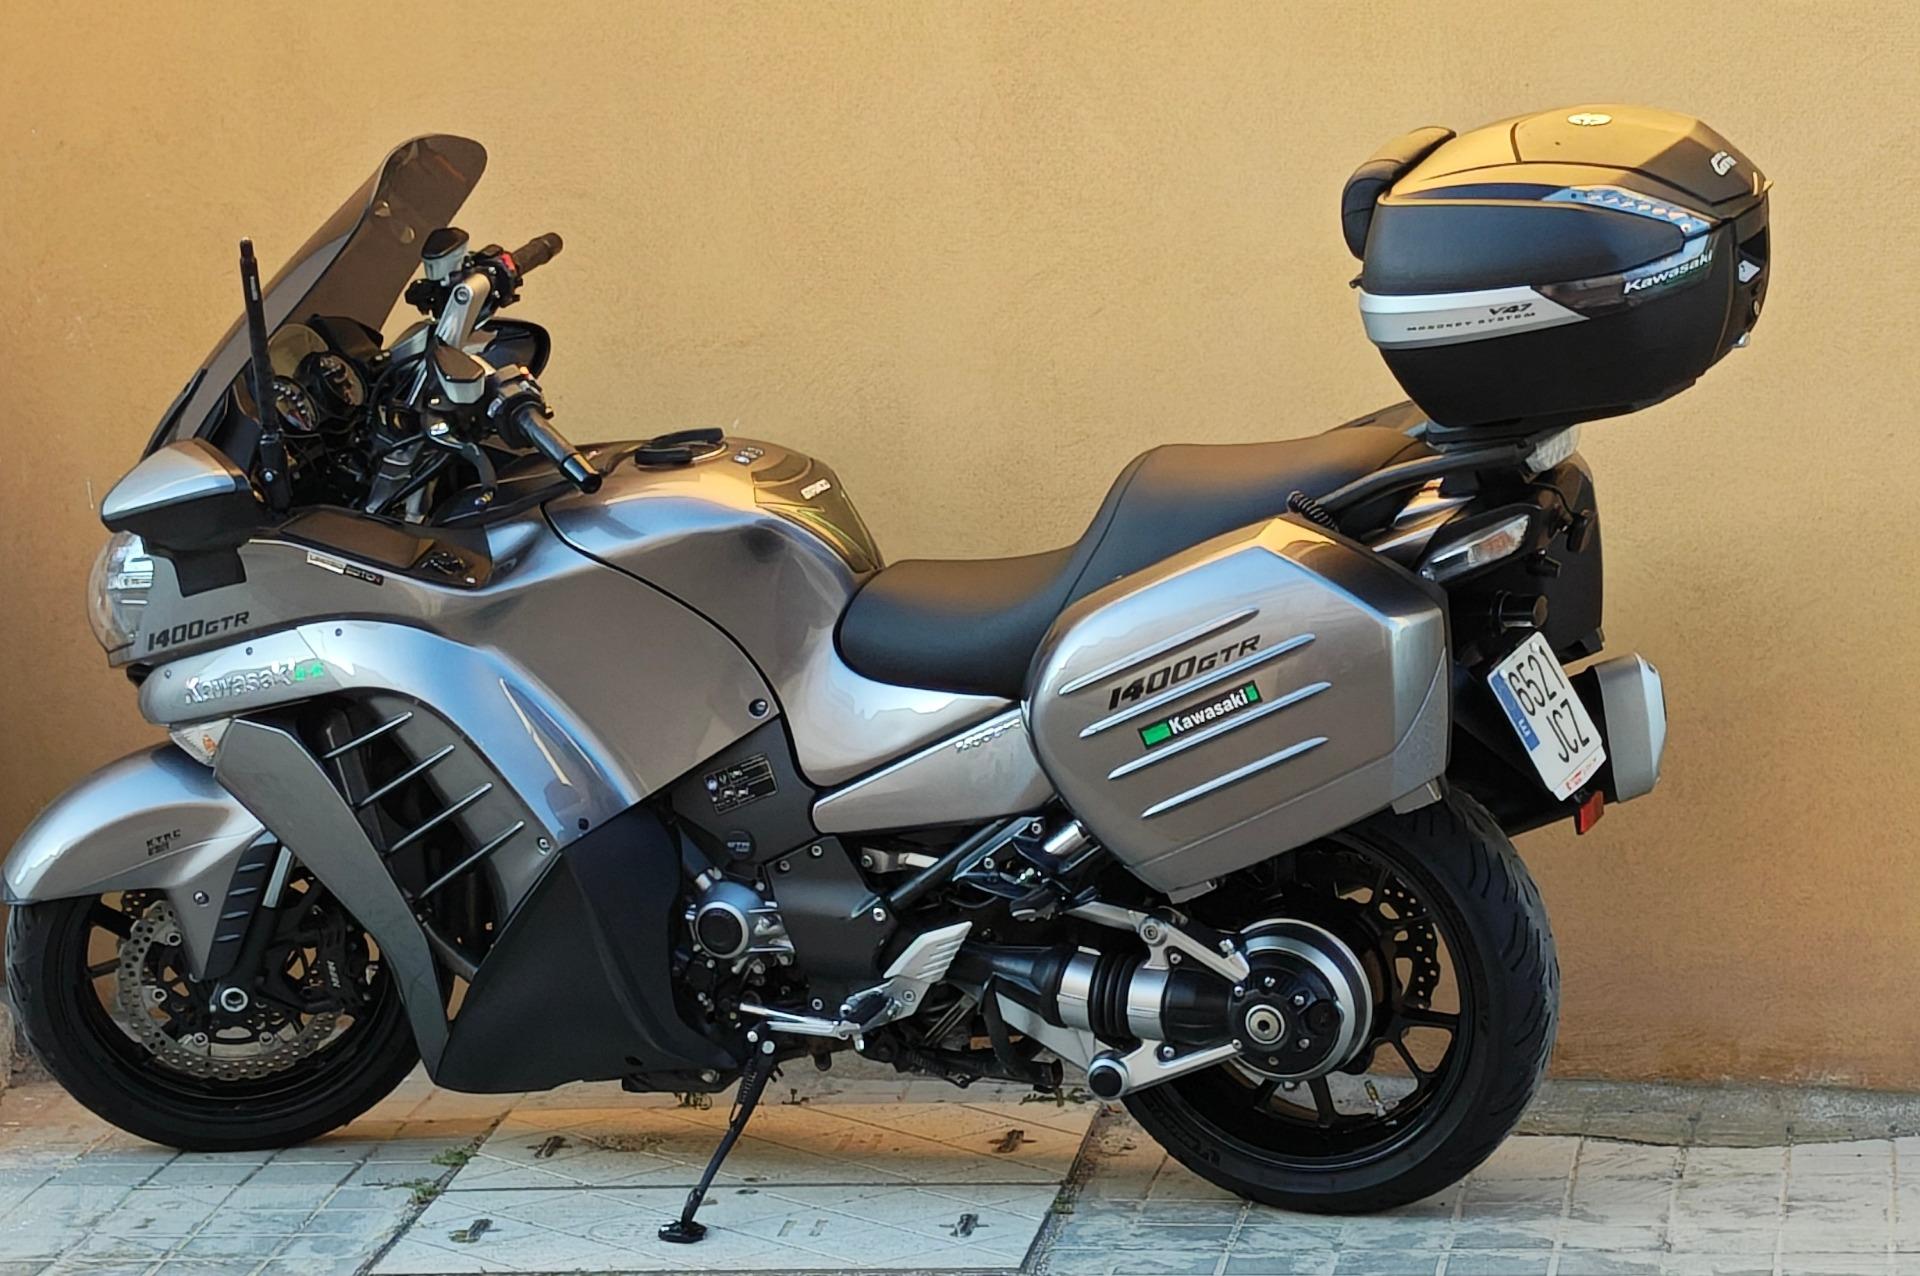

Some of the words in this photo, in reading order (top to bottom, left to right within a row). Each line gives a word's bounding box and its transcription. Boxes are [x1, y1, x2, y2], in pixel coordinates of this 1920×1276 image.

[1623, 249, 1713, 295] Kawasaki
[1489, 302, 1533, 316] V47
[148, 610, 251, 652] 1400GTR
[185, 658, 296, 705] Kawasaki
[1108, 634, 1261, 711] 1400GTR
[1508, 645, 1565, 717] 6521
[1168, 688, 1249, 736] Kawasaki
[1518, 719, 1531, 738] E
[1546, 698, 1590, 763] JCZ
